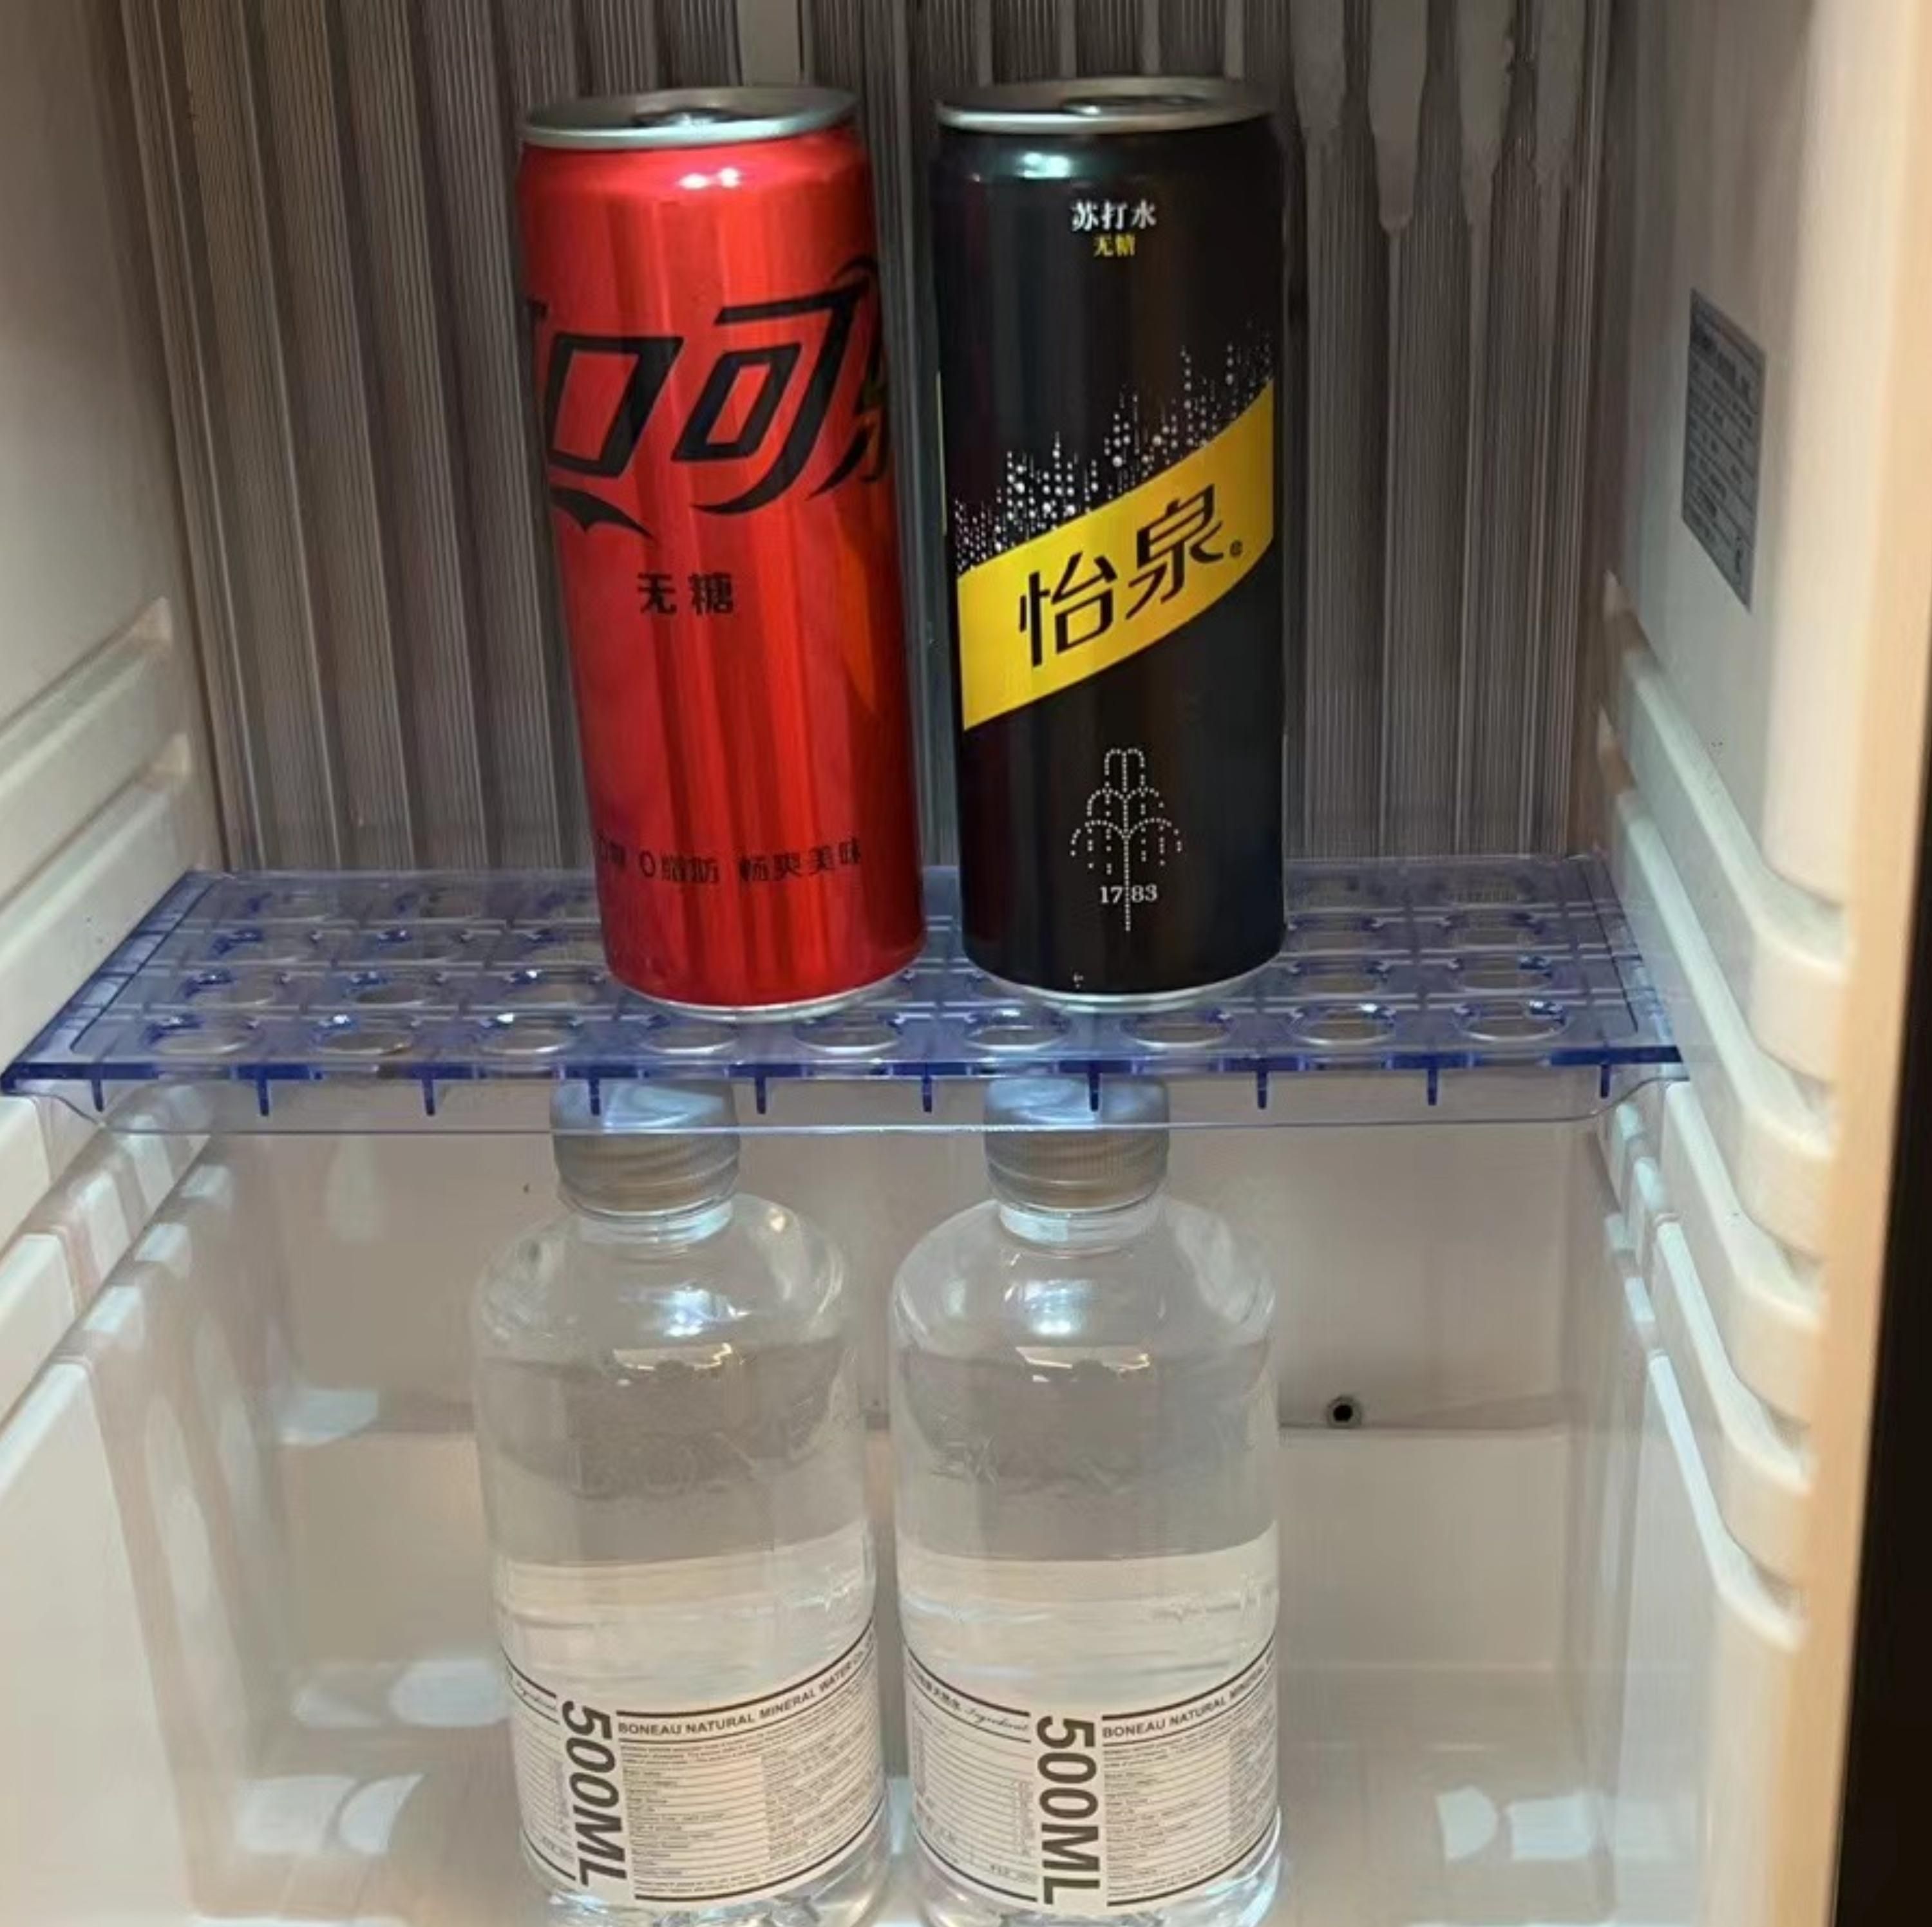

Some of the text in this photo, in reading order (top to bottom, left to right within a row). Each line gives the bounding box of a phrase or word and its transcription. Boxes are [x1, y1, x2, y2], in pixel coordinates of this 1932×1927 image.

[1072, 199, 1157, 232] 苏打水
[637, 572, 734, 614] 无糖
[1019, 484, 1225, 668] 怡泉
[1099, 883, 1158, 904] 1783
[618, 1722, 681, 1736] BONEAU
[685, 1713, 756, 1734] NATURAL
[760, 1688, 816, 1718] MINERAL
[1102, 1718, 1166, 1738] BONEAU
[1170, 1697, 1226, 1725] NATURAL
[561, 1700, 627, 1886] 500ML
[1036, 1715, 1101, 1905] 500ML
